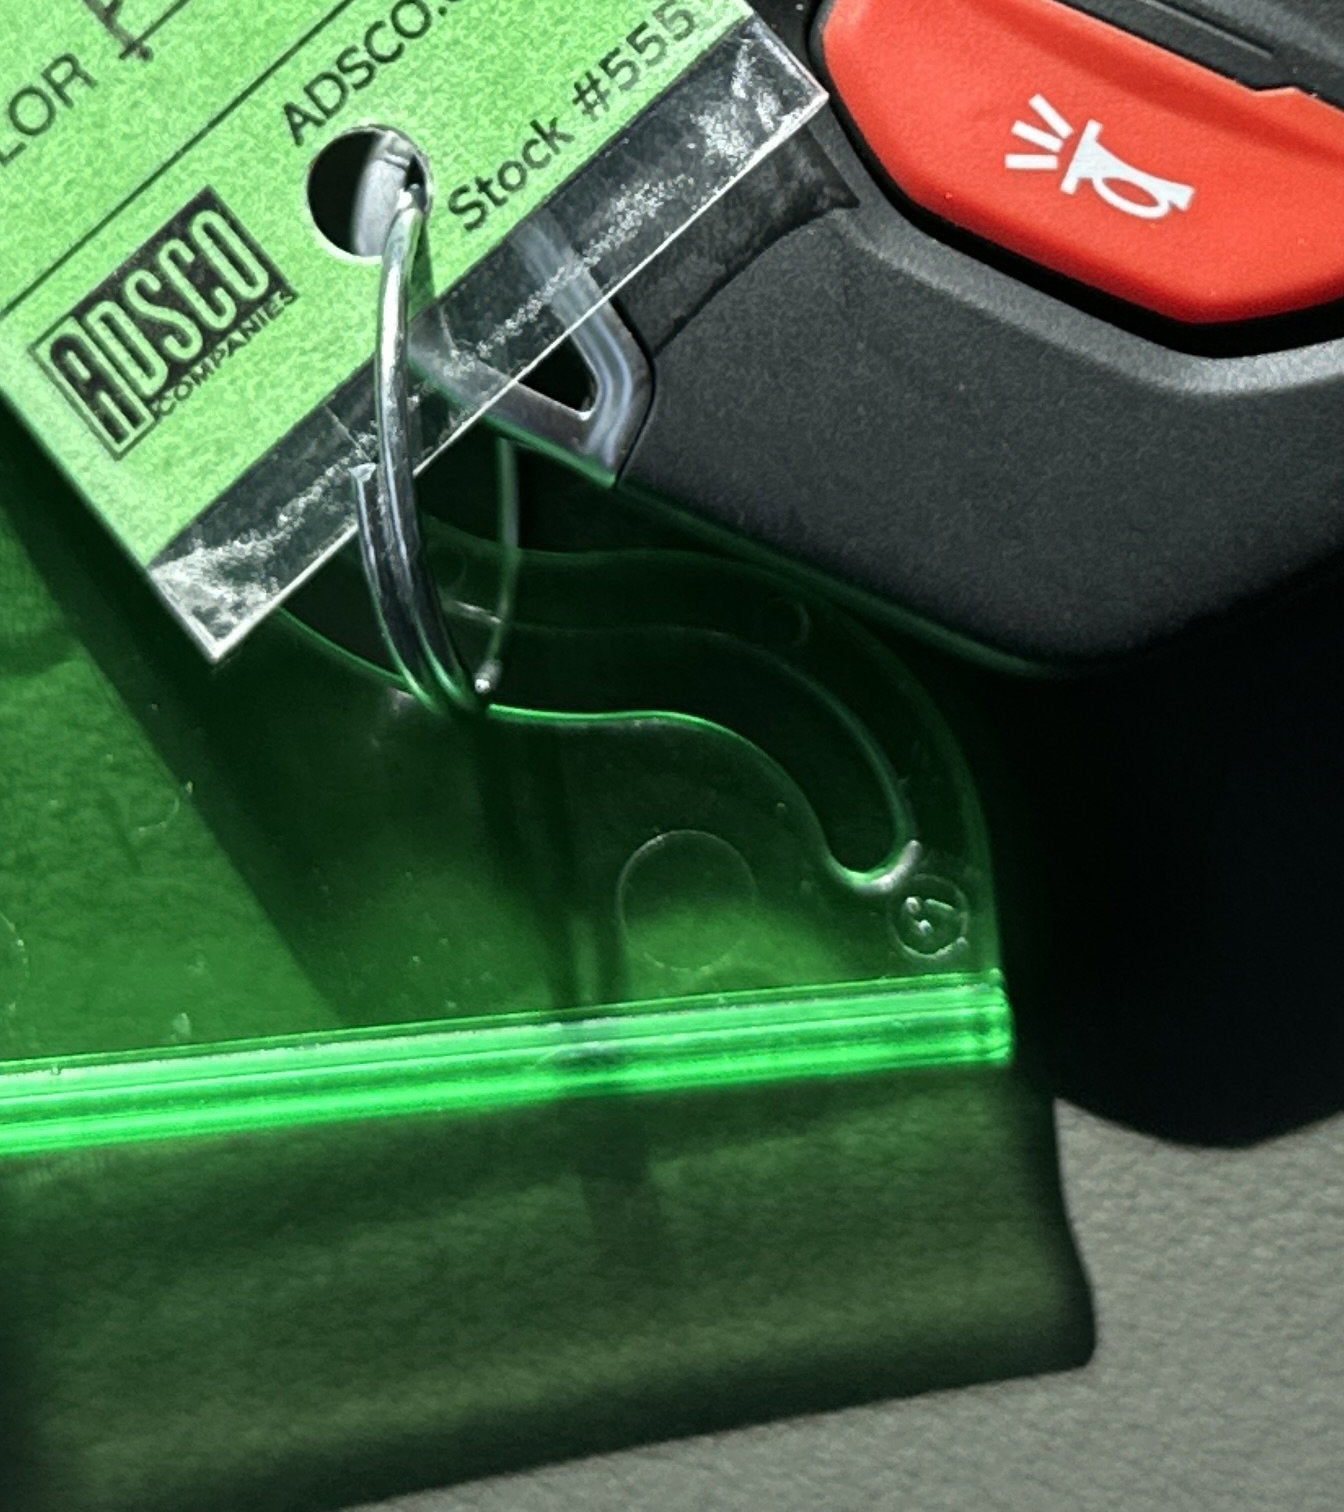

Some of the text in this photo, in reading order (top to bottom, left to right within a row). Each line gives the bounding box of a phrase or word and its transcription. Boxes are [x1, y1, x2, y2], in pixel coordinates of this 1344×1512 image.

[447, 117, 573, 231] Stock
[50, 209, 272, 443] ADSCO
[154, 287, 298, 418] COMPANIES
